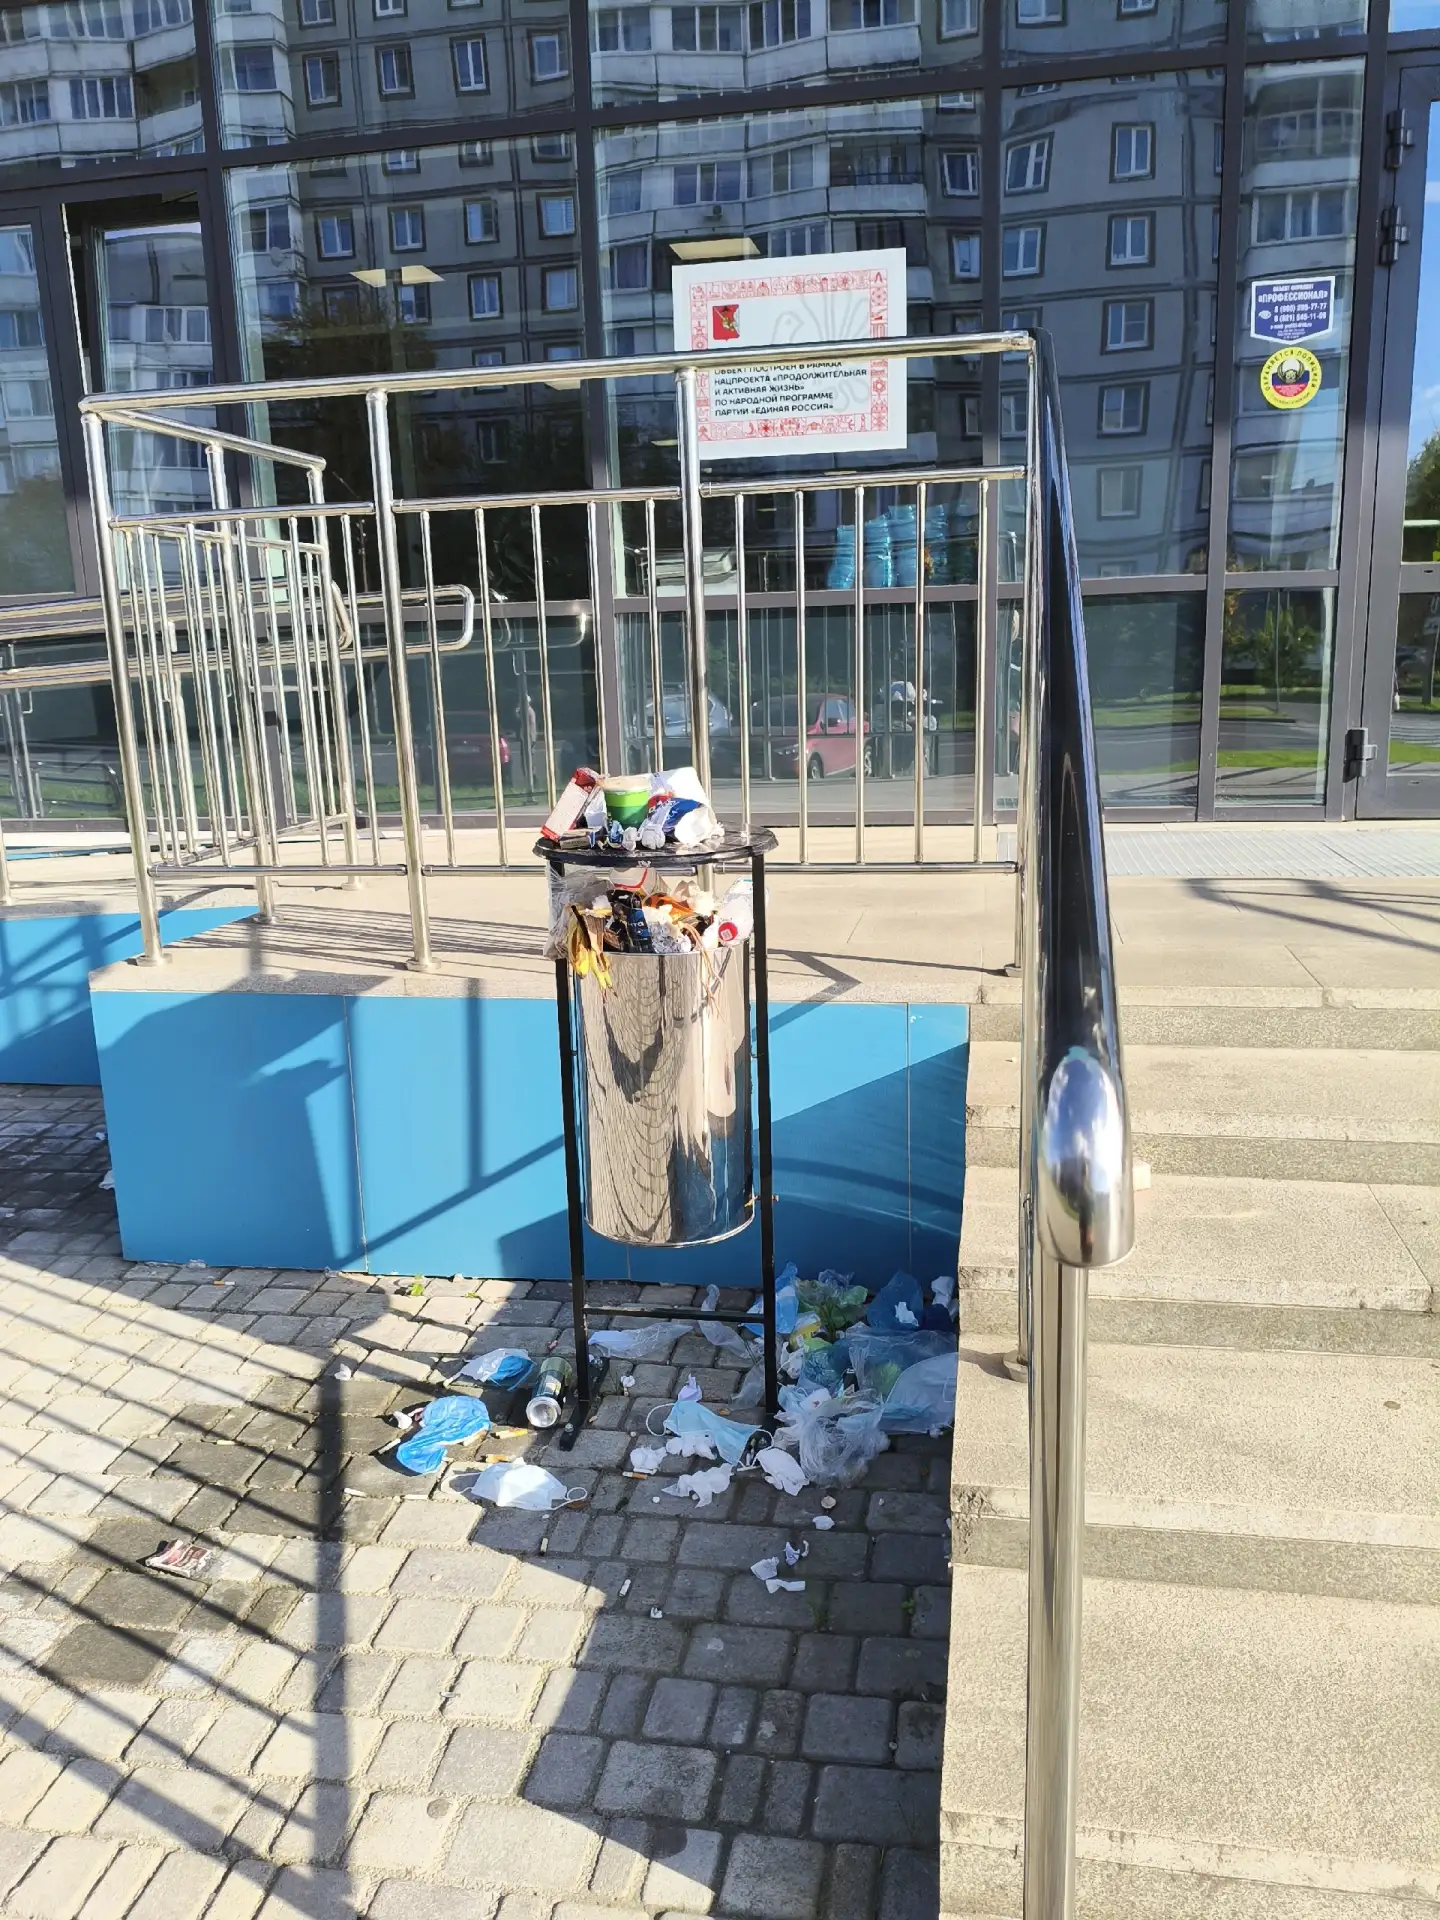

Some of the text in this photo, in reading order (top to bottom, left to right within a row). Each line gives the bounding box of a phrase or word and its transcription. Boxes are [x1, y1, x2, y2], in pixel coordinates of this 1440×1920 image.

[714, 369, 867, 386] НАЦПРОЕКТА «ПРОДОЛЖИТЕЛЬНАЯ
[715, 384, 805, 396] И АКТИВНАЯ ЖИЗНЬ»
[715, 392, 834, 406] ПО НАРОДНОЙ ПРОГРАММЕ
[715, 403, 834, 417] ПАРТИИ «ЕДИНАЯ РОССИЯ»
